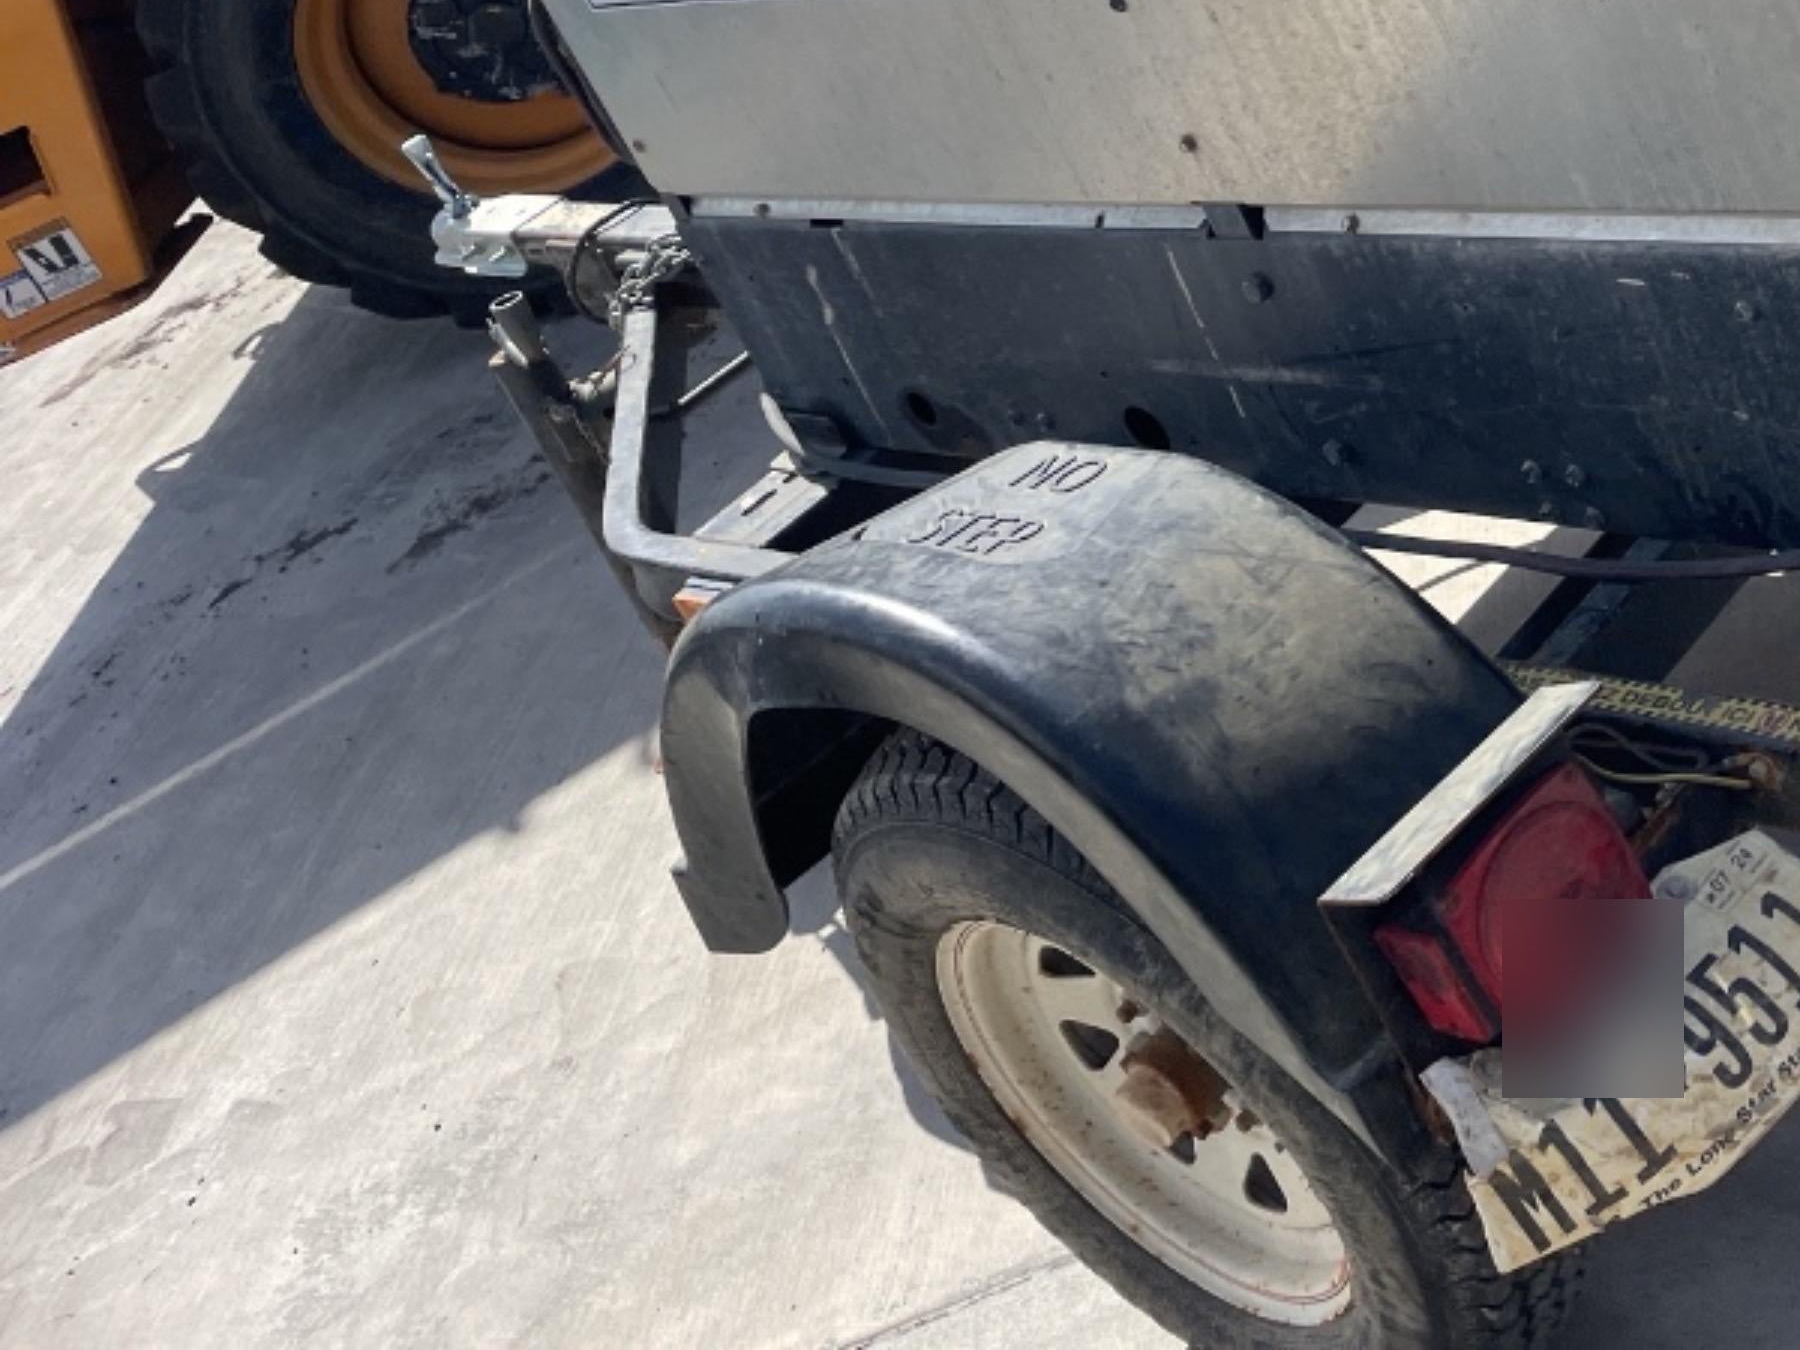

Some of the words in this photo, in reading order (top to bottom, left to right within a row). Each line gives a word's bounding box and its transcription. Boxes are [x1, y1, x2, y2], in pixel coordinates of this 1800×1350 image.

[1008, 454, 1109, 494] NO
[908, 508, 1046, 556] STEP
[1640, 1178, 1682, 1208] The
